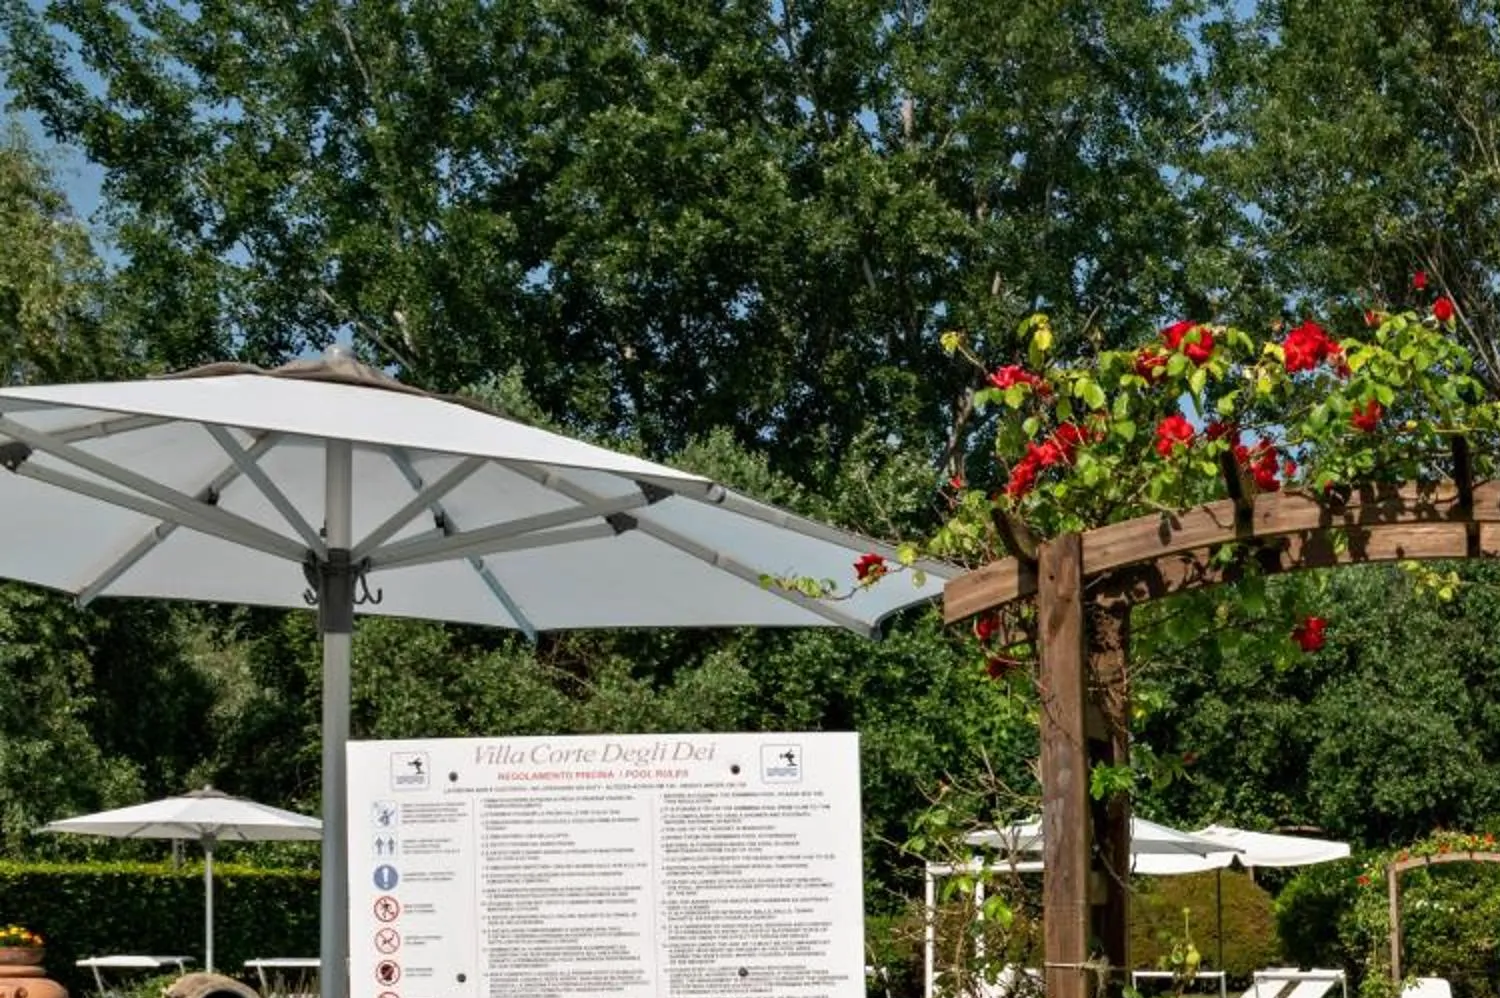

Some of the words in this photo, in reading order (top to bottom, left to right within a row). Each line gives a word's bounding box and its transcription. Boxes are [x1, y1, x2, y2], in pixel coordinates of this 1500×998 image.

[475, 743, 524, 765] Villa
[530, 743, 594, 764] Corte
[601, 741, 668, 767] Degli
[672, 741, 717, 762] Dei
